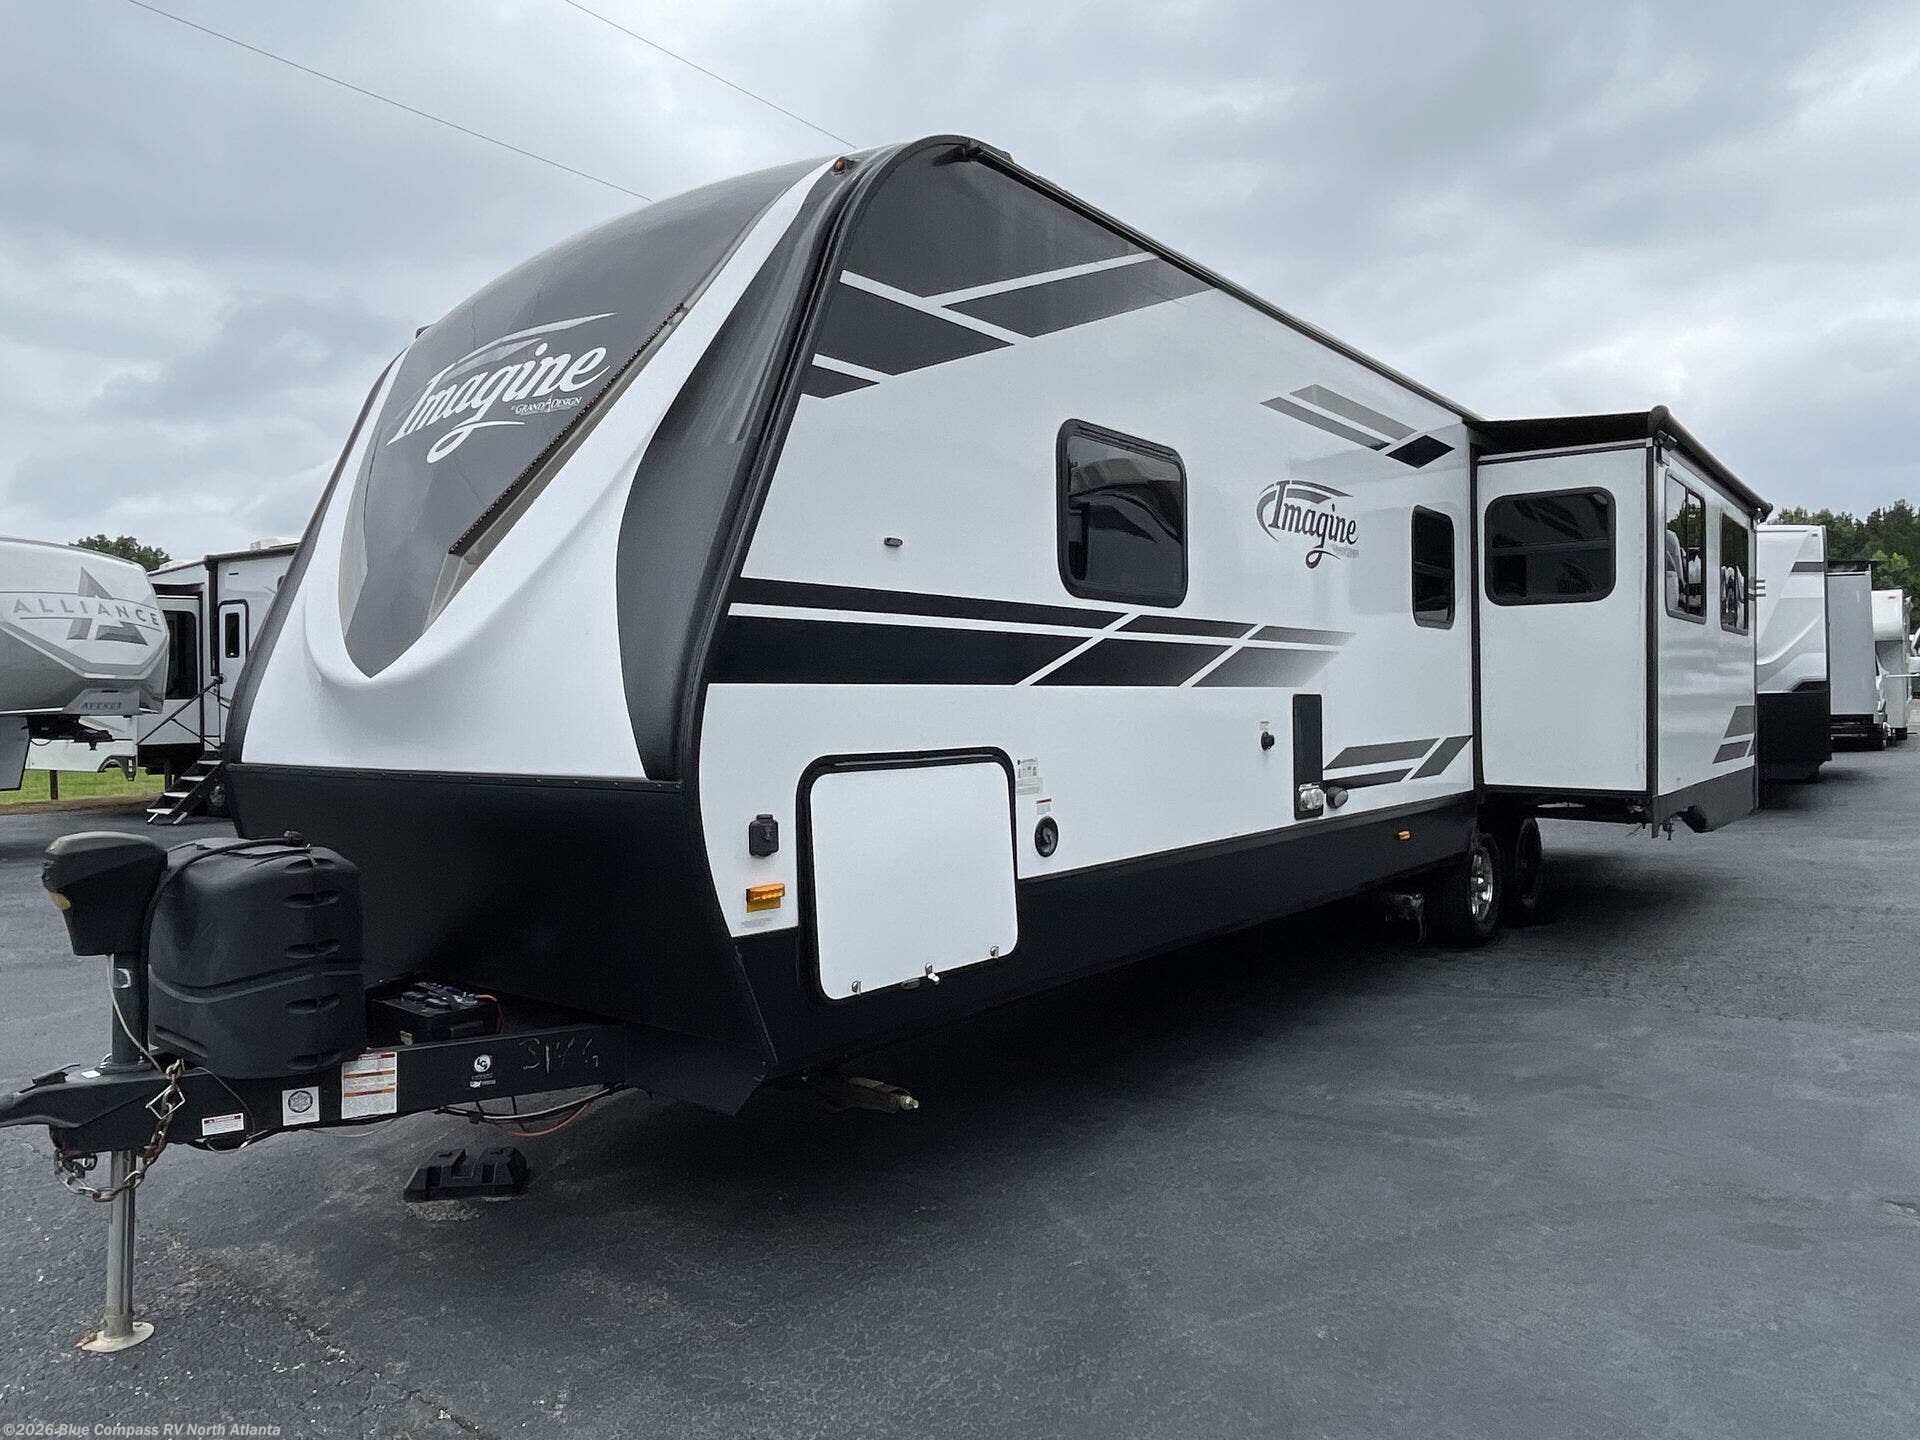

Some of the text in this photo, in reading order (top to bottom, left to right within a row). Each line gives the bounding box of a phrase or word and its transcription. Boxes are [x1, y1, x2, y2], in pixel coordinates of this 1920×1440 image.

[386, 342, 611, 464] Imagine
[1266, 479, 1360, 569] Imagine
[13, 598, 160, 626] ALLIANCE
